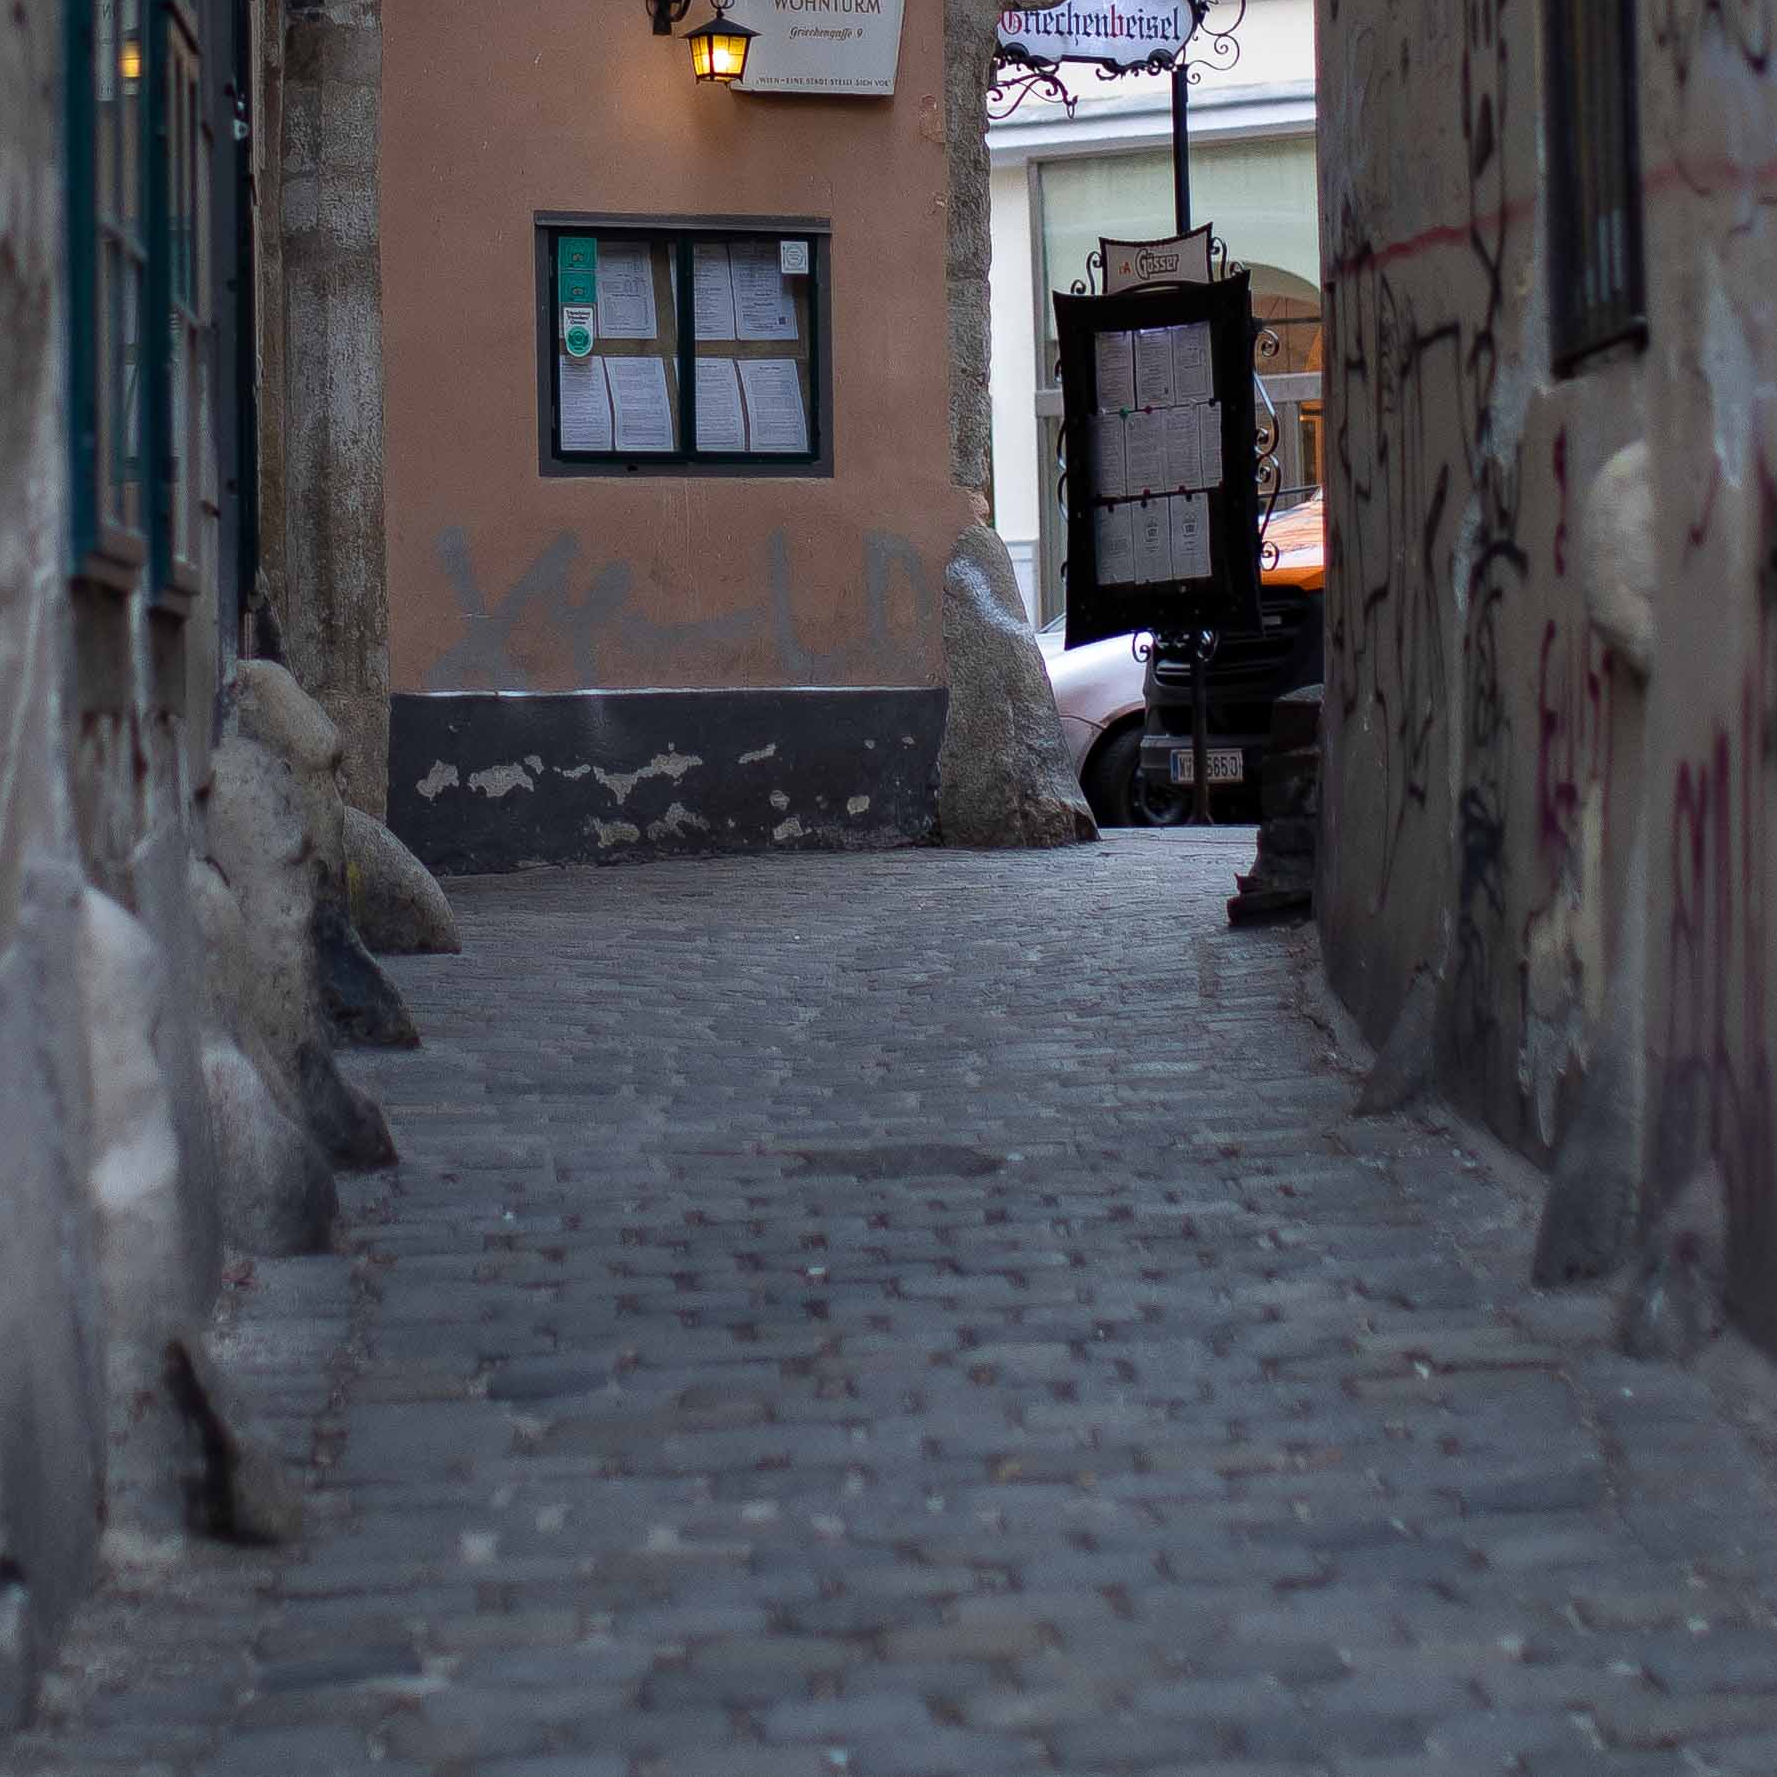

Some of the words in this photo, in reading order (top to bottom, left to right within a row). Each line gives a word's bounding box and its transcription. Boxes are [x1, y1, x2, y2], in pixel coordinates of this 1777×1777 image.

[856, 27, 864, 39] 9
[1000, 2, 1181, 47] Griechenbeisel
[1135, 248, 1179, 280] Gösser
